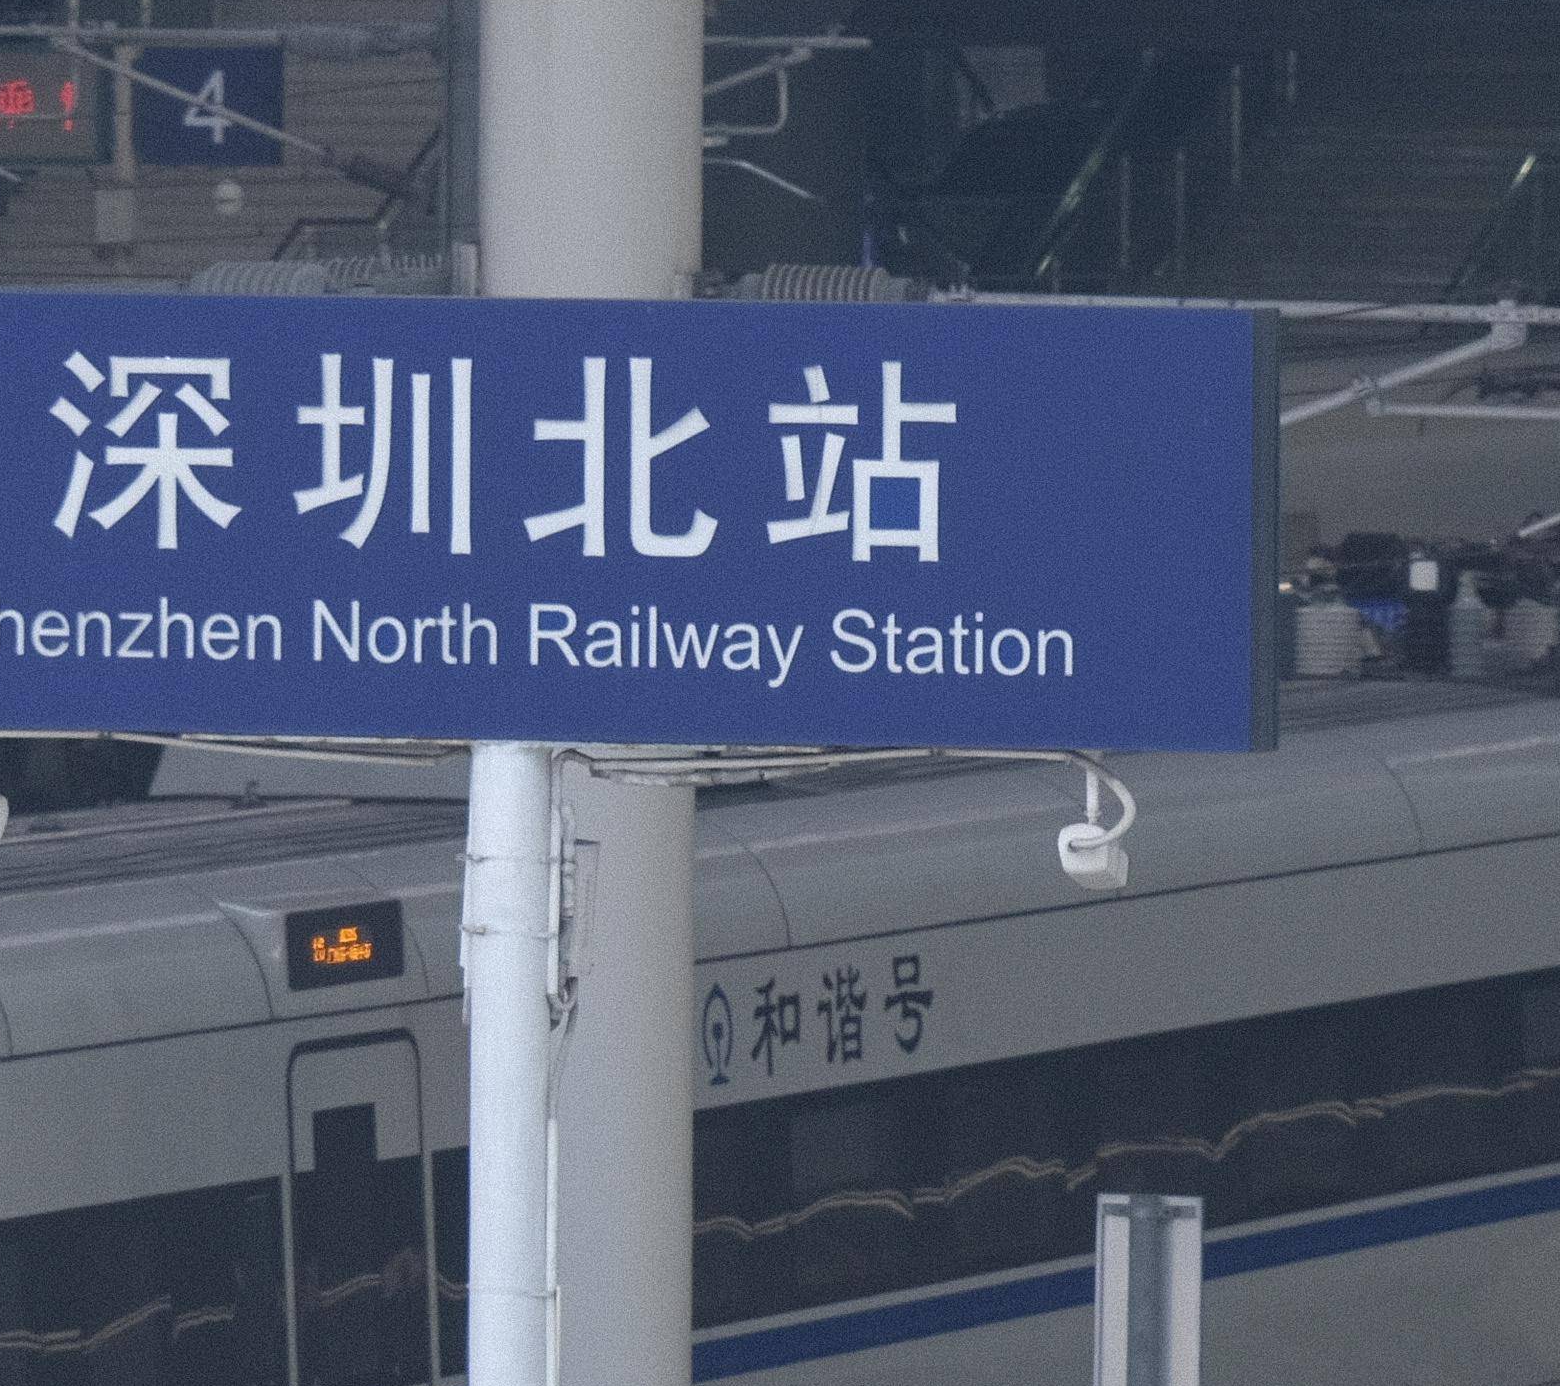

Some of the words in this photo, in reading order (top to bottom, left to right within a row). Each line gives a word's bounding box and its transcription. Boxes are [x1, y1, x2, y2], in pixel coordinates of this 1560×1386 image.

[183, 70, 234, 144] 4
[48, 350, 958, 563] 深圳北站
[312, 598, 498, 667] North
[528, 603, 805, 690] Railway
[829, 610, 1076, 679] Station
[750, 953, 934, 1074] 和谐号
